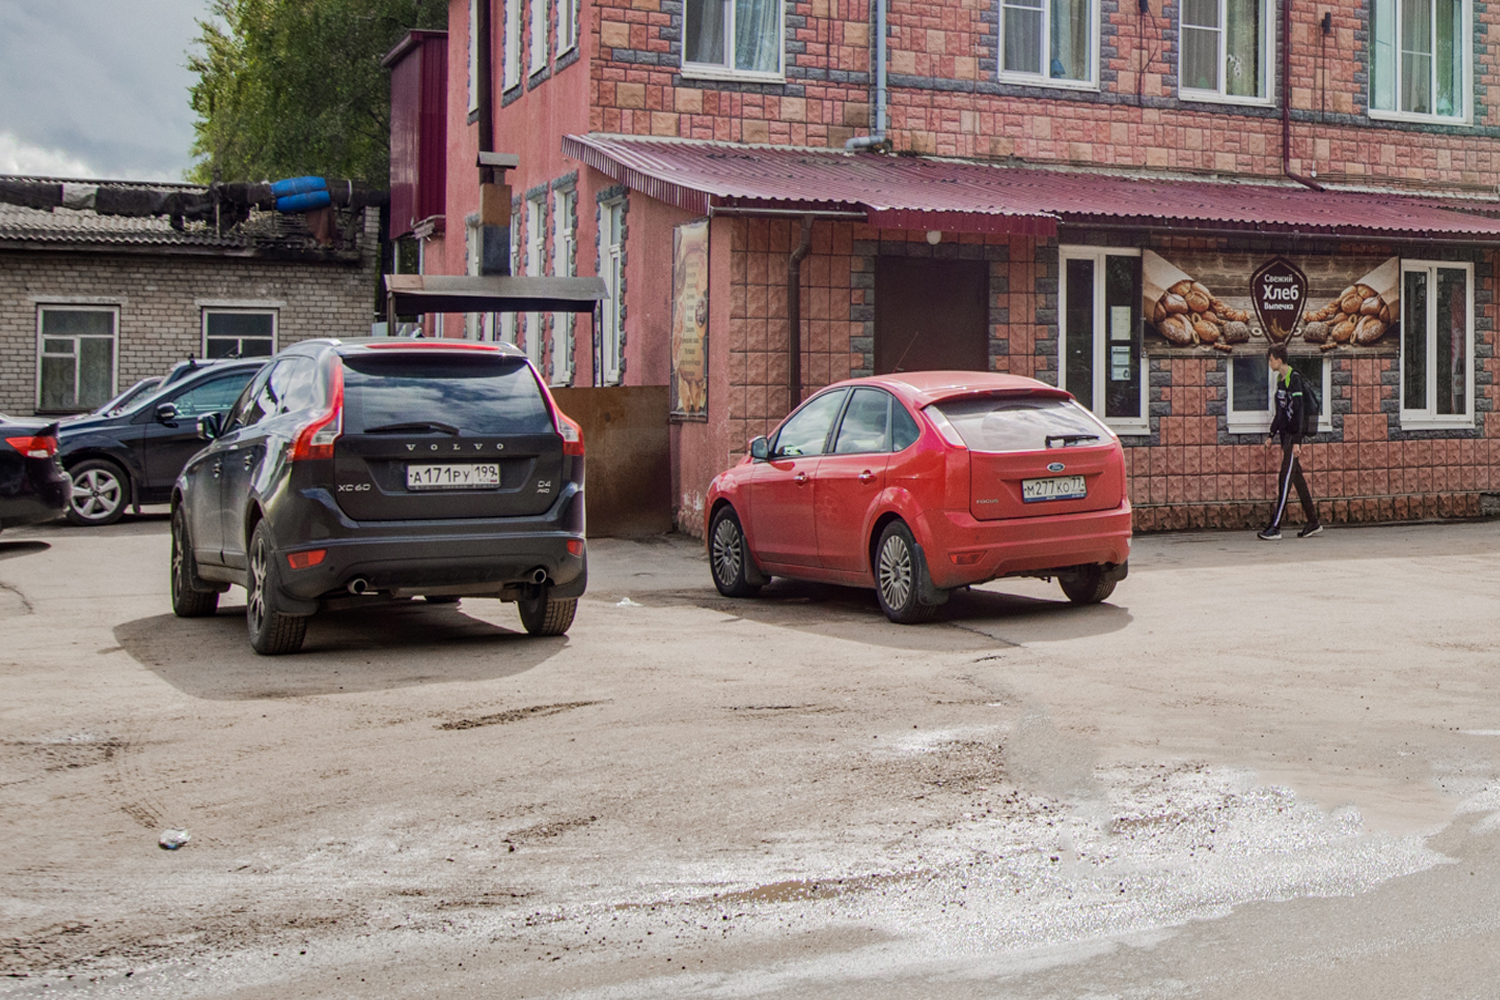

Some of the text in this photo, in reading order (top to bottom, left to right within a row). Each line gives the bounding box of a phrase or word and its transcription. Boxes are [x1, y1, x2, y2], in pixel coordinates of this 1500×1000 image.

[1264, 273, 1293, 283] Свежий
[1262, 284, 1299, 300] Хлеб
[1264, 301, 1294, 310] Выпечка
[406, 443, 504, 451] VOLVO
